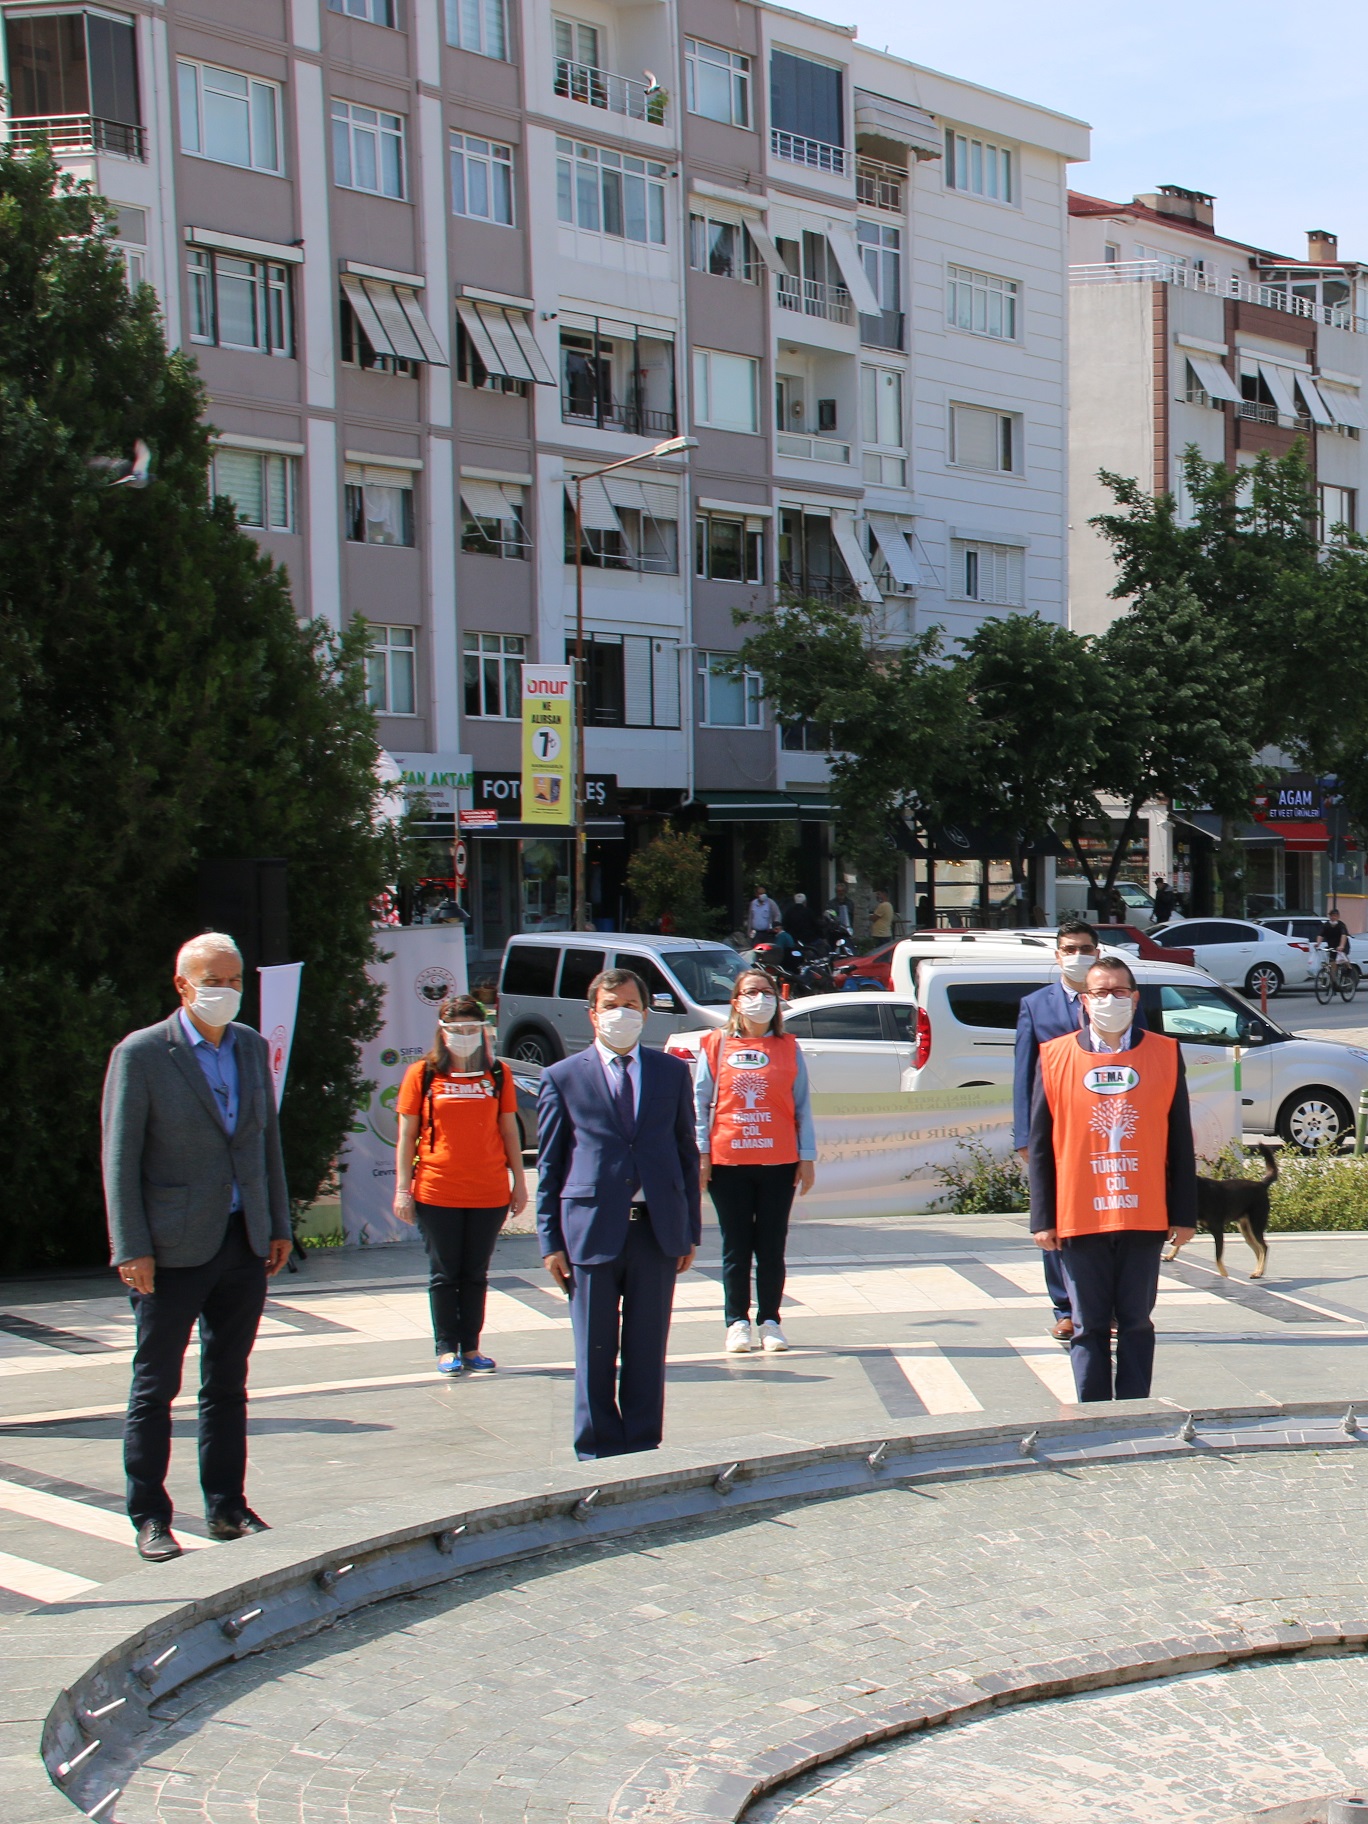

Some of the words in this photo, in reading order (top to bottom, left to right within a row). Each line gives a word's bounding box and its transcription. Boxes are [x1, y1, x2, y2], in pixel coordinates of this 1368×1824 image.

[527, 679, 568, 694] onur
[542, 701, 552, 711] NE
[531, 714, 562, 724] ALIRSAN
[482, 779, 522, 799] FOT
[1278, 789, 1312, 805] AGAM
[1269, 809, 1277, 817] ET
[1286, 809, 1293, 817] ET
[400, 1047, 423, 1056] SIFIR
[736, 1053, 758, 1062] TEMA
[1094, 1071, 1124, 1083] TEMA
[443, 1082, 481, 1094] TEMA
[732, 1110, 772, 1124] TÜRKİYE
[742, 1123, 762, 1139] ÇÖL
[731, 1138, 773, 1149] OLMASIN
[1090, 1154, 1139, 1175] TÜRKİYE
[1106, 1173, 1130, 1195] ÇÖL
[1093, 1194, 1139, 1212] OLMASIN
